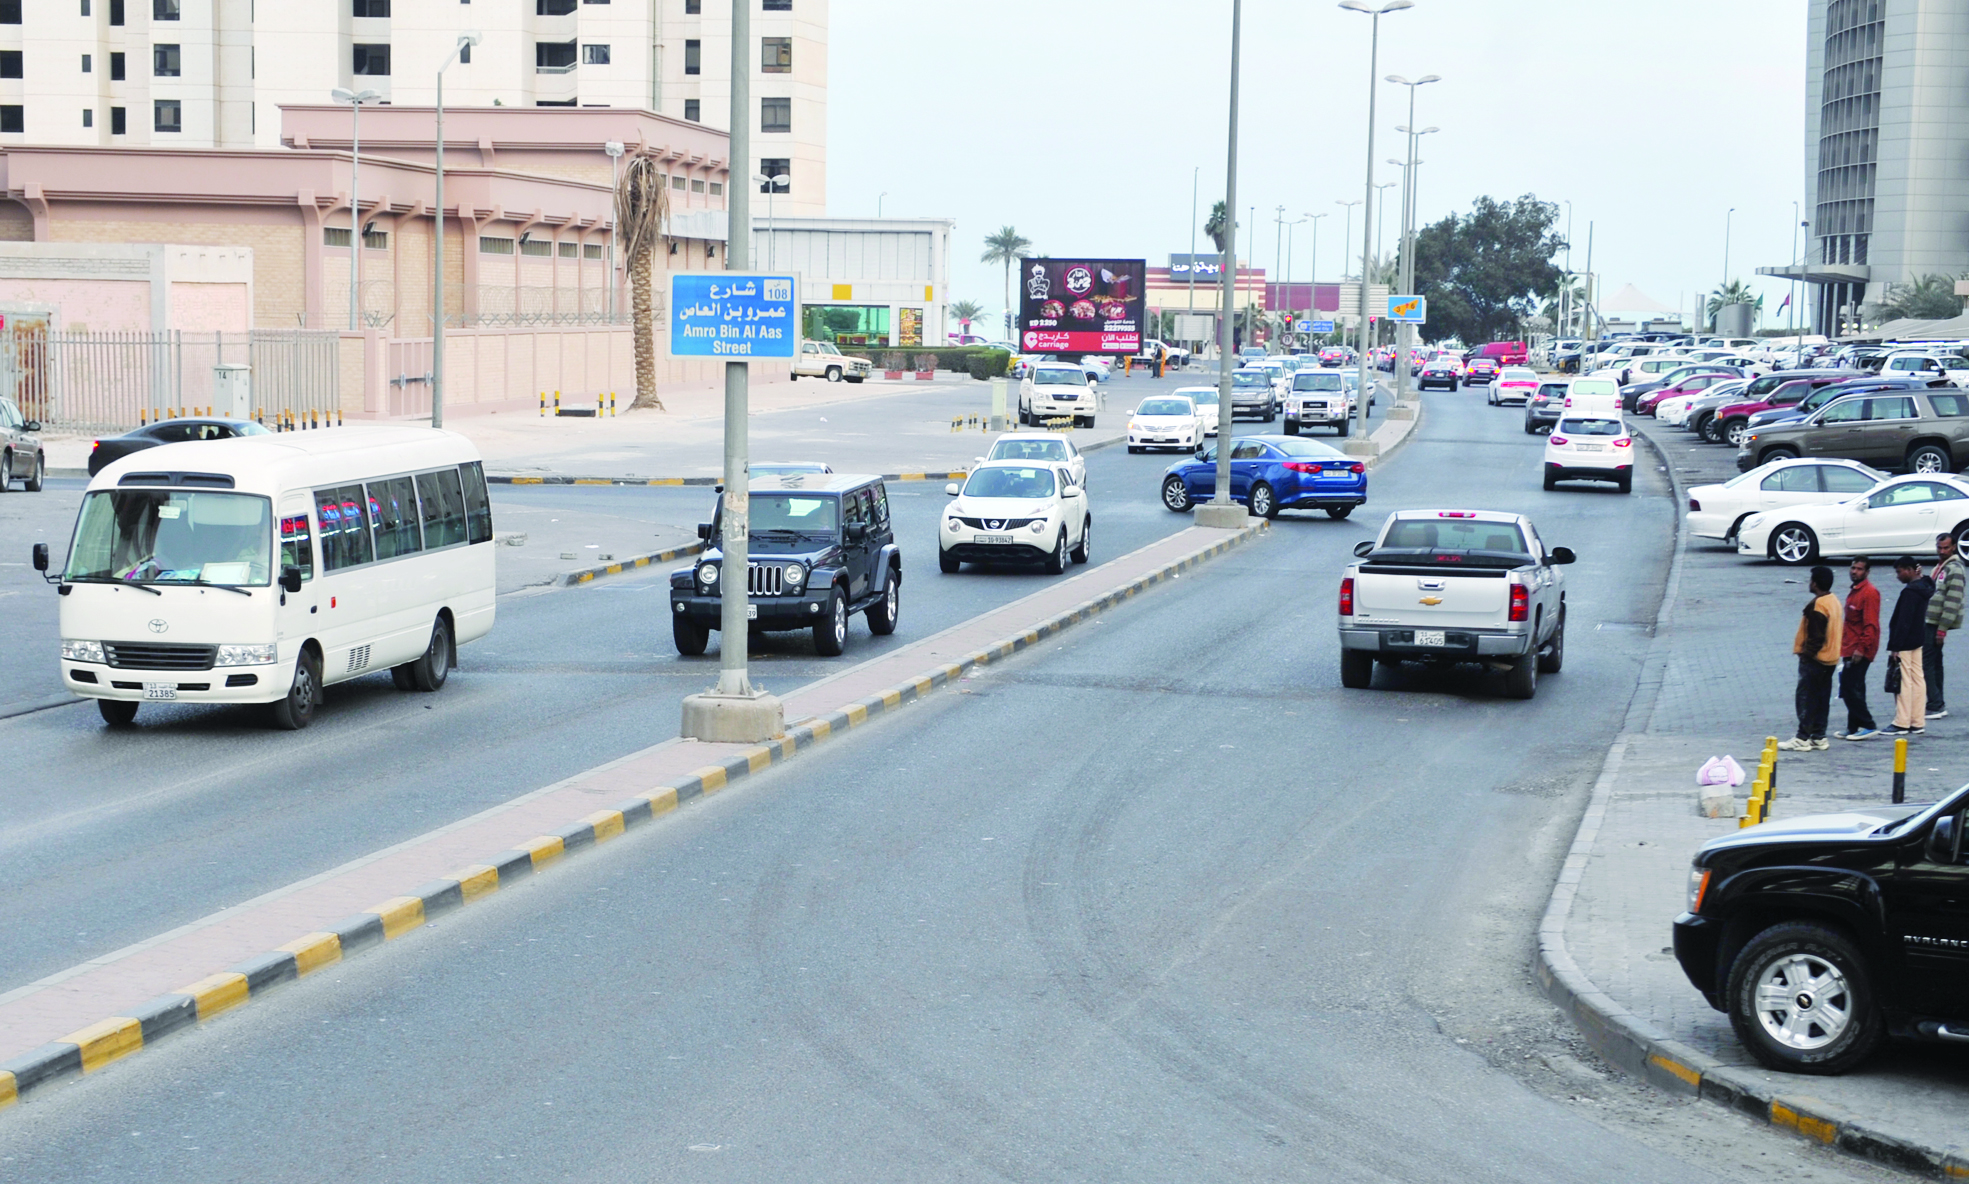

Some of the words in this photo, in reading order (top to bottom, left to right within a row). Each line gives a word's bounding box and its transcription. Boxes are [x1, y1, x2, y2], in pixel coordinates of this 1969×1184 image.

[1067, 278, 1075, 288] 3
[1082, 277, 1092, 288] 2
[709, 281, 756, 300] شارع
[768, 288, 788, 300] 108
[679, 301, 720, 321] العاص
[723, 303, 743, 322] بن
[744, 306, 787, 322] عمرو
[683, 323, 716, 338] Amro
[720, 324, 740, 338] Bin
[743, 324, 755, 339] Al
[759, 325, 783, 339] Aas
[713, 340, 752, 354] Street
[149, 690, 175, 698] 21385
